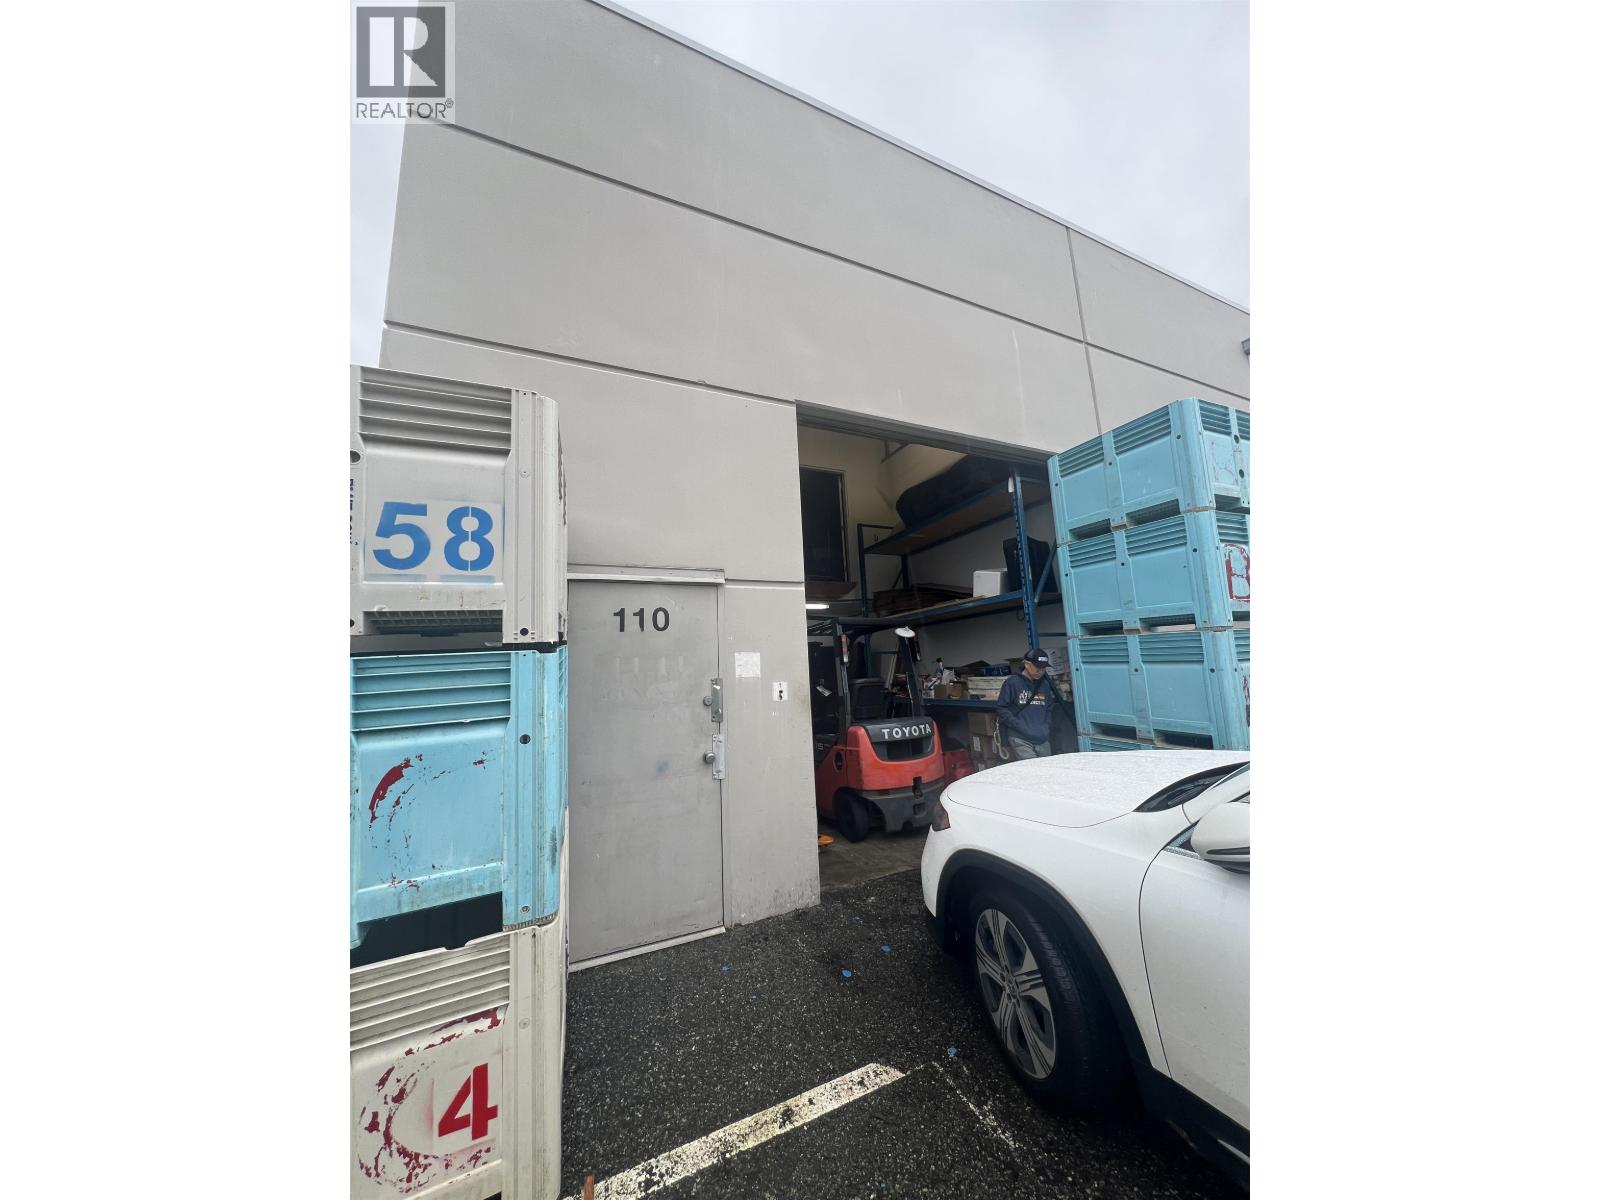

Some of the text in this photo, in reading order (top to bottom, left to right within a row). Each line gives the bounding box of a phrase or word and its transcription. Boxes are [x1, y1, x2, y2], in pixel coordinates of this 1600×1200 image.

[373, 501, 495, 572] 58
[613, 607, 670, 633] 110
[881, 723, 932, 740] TOYOTA
[437, 1062, 499, 1142] 4
